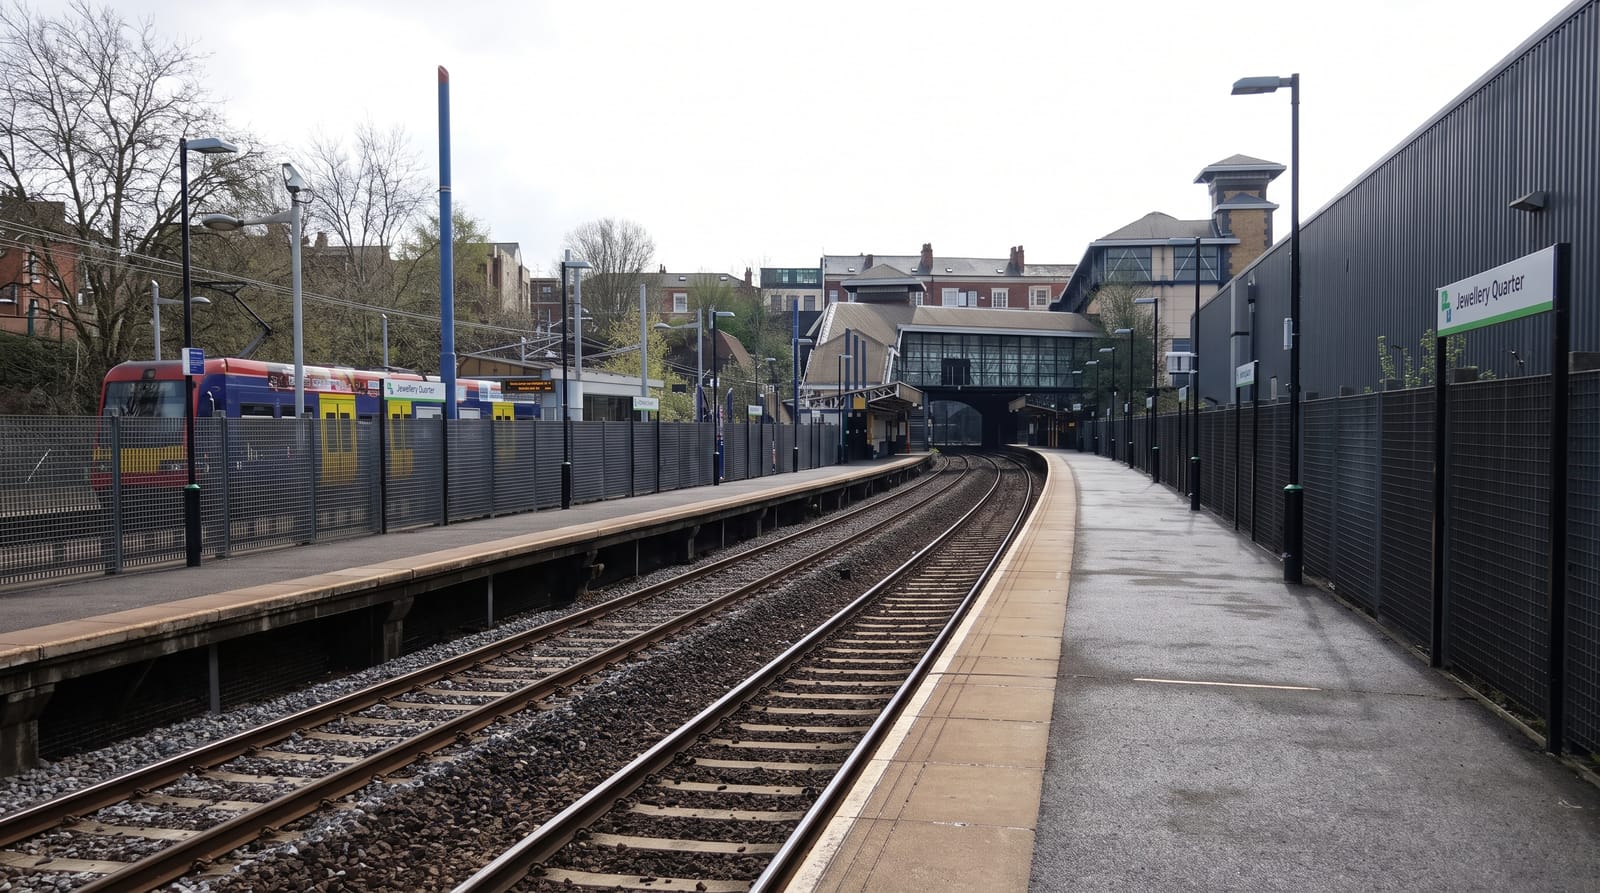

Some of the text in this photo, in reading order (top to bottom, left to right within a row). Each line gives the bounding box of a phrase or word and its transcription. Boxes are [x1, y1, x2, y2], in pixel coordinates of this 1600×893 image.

[1456, 274, 1525, 310] Jewellery Quarter
[397, 384, 435, 394] Jewellery Quarter
